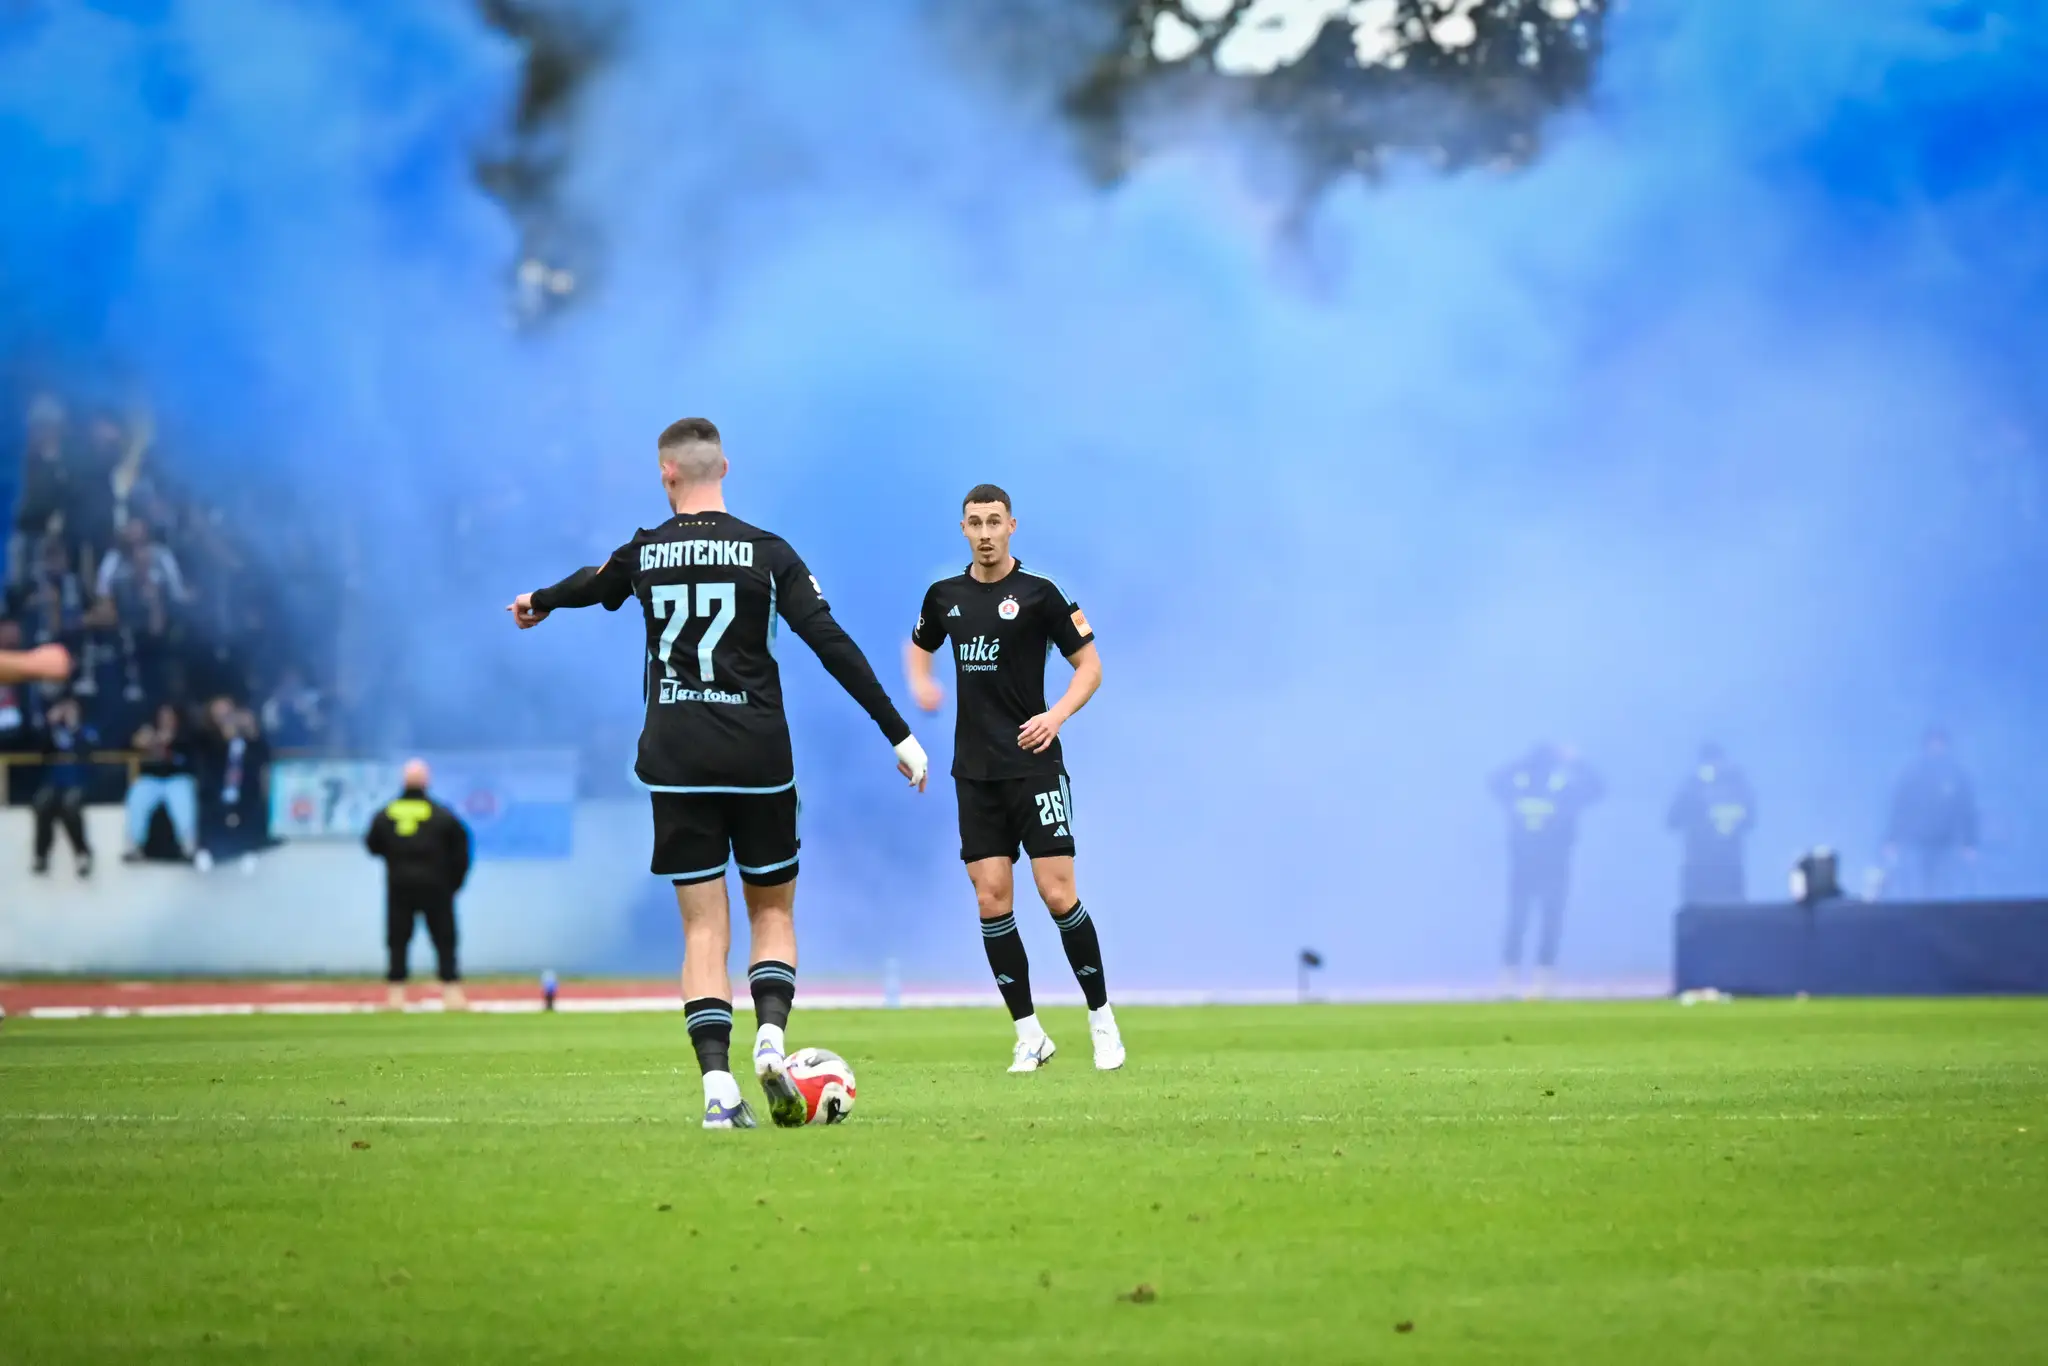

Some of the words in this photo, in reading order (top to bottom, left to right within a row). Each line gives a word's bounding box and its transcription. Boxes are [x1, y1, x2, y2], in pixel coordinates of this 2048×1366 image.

[640, 540, 753, 572] IGNATENKO
[651, 582, 736, 682] 77
[959, 635, 1000, 661] niké
[1035, 790, 1066, 826] 26
